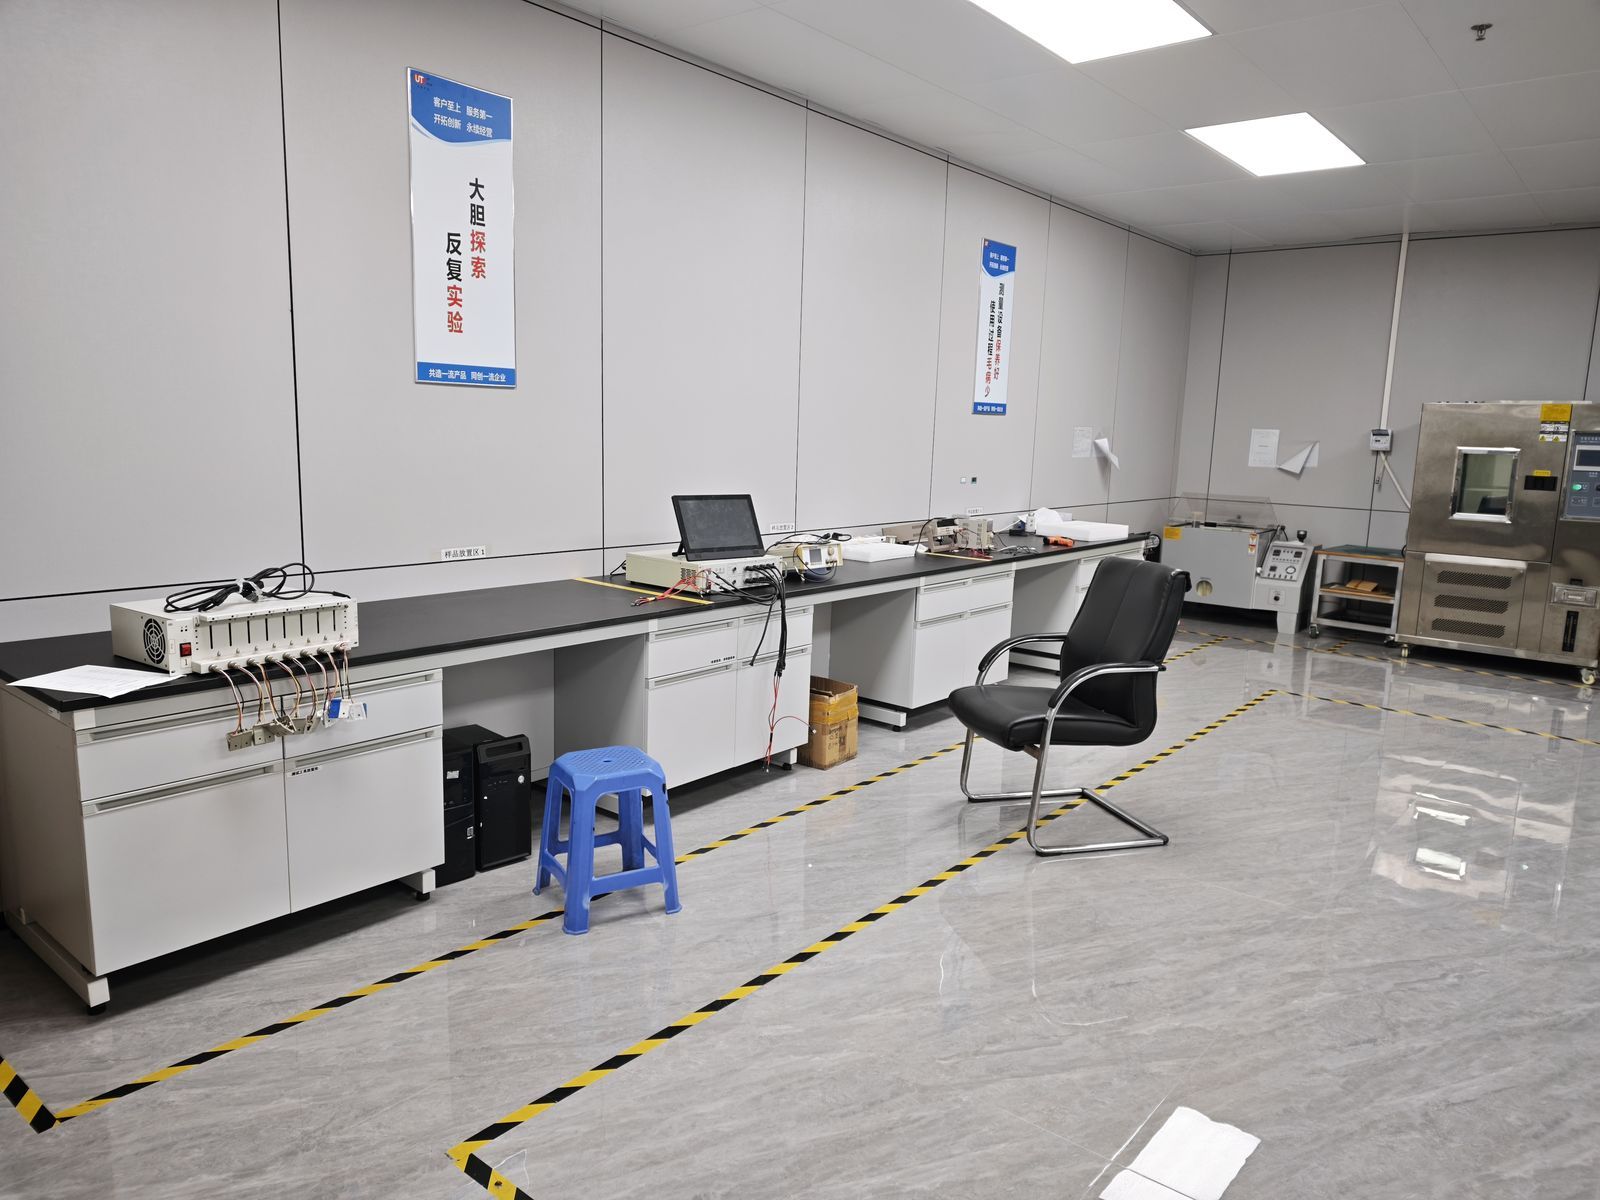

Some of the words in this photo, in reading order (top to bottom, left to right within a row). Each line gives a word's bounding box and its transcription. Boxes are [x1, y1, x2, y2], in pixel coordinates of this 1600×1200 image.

[414, 74, 425, 84] UT
[433, 97, 462, 113] 客户至上
[466, 105, 493, 120] 服务第一
[433, 113, 462, 130] 开拓创新
[466, 122, 493, 138] 永续经营
[469, 177, 486, 279] 大胆探索
[446, 232, 463, 334] 反复实验
[470, 371, 507, 382] 同创一流企业
